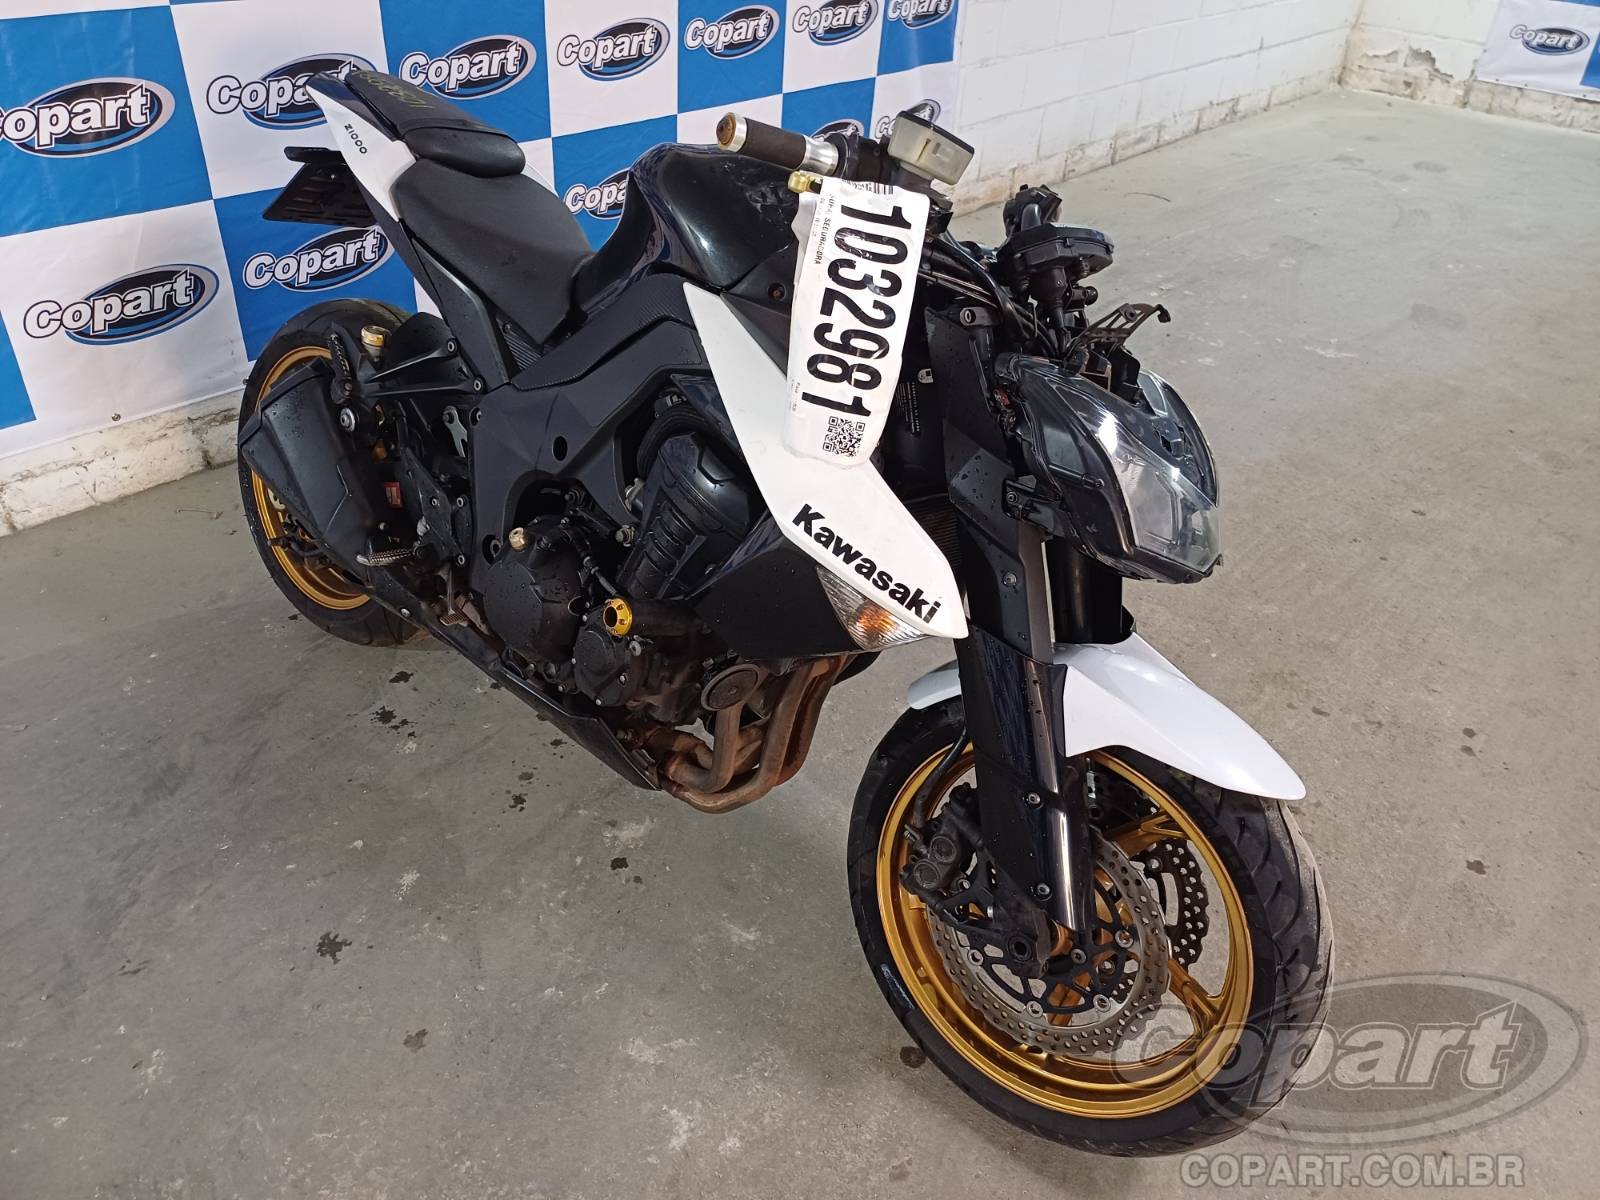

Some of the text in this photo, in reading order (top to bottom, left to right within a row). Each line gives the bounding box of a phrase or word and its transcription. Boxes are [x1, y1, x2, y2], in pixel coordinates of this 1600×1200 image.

[557, 18, 658, 70] Copart
[684, 7, 773, 50] Copart
[793, 0, 870, 37] Copart
[1509, 24, 1582, 49] Copart
[401, 35, 523, 91] Copart
[0, 80, 150, 149] opart
[244, 229, 380, 290] Copart
[23, 267, 196, 339] Copart
[801, 204, 912, 417] 1032981
[791, 503, 942, 624] Kawasaki
